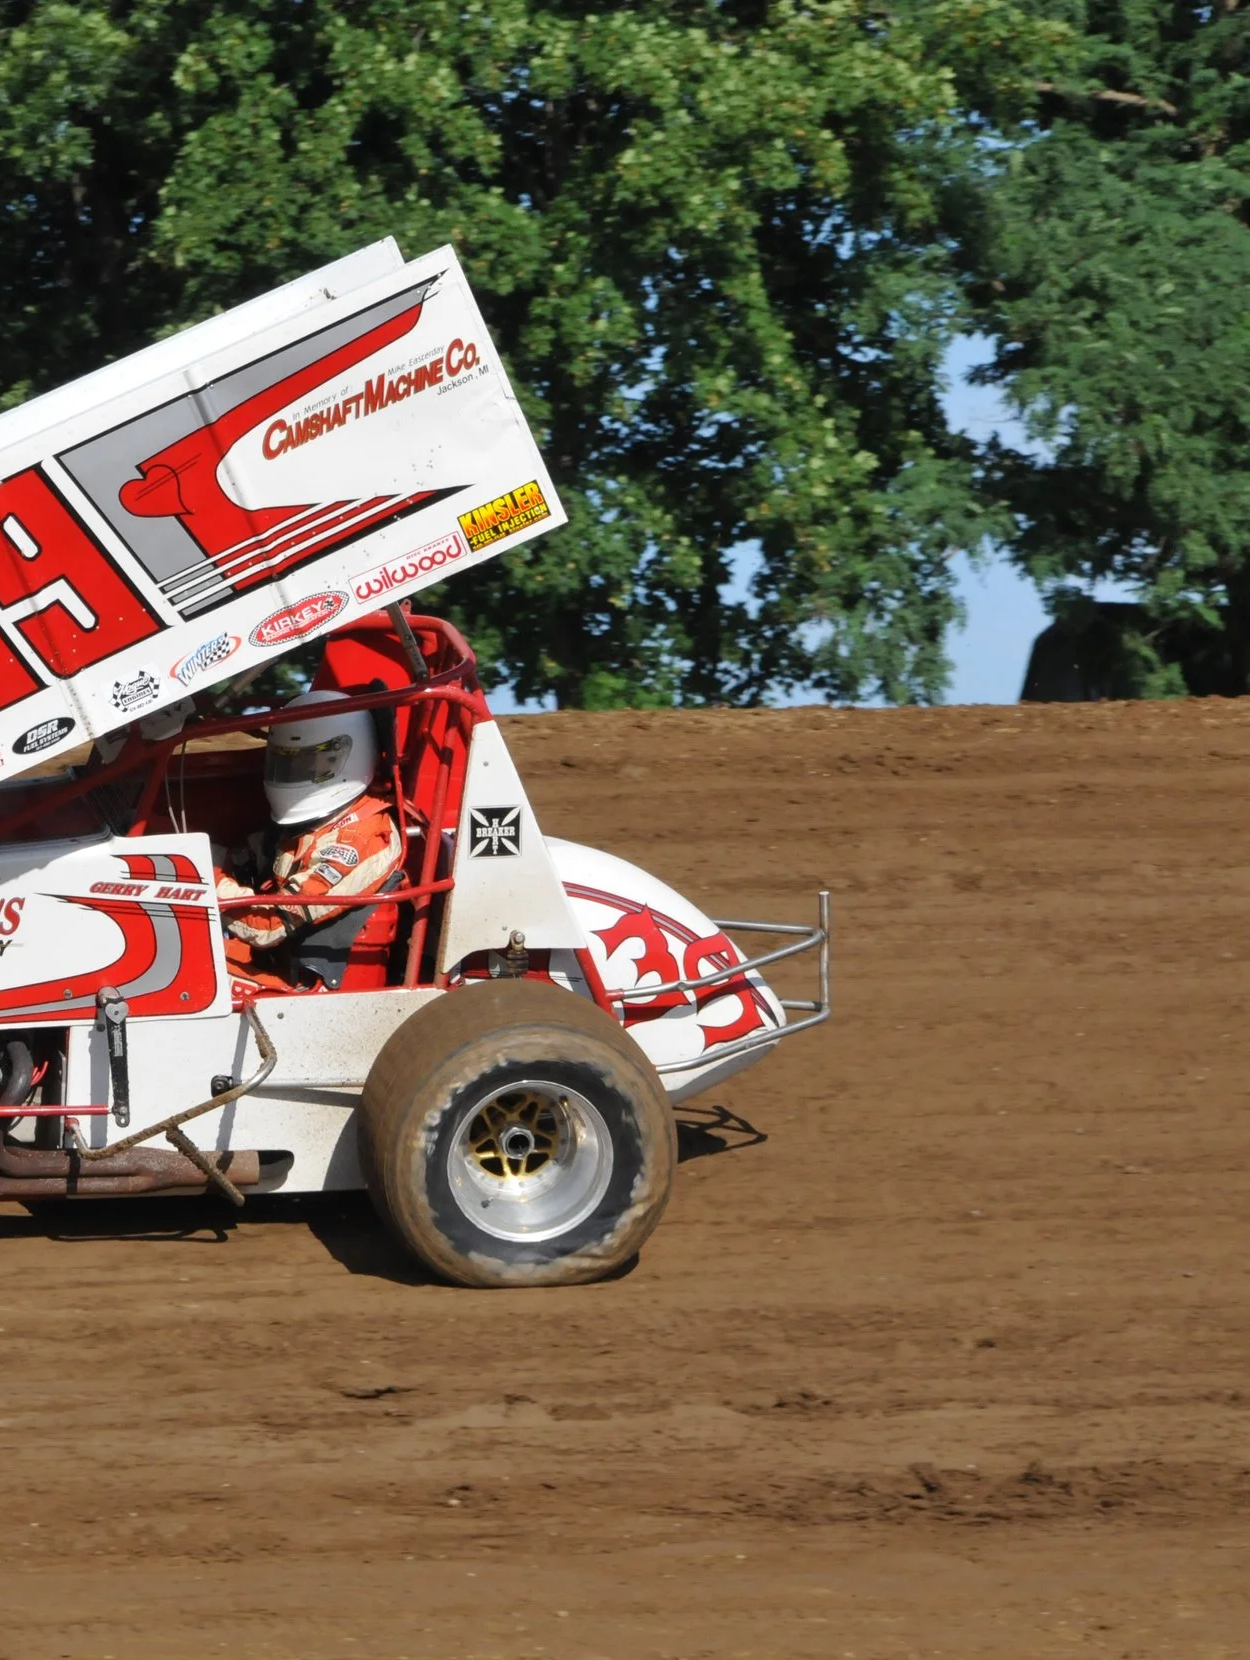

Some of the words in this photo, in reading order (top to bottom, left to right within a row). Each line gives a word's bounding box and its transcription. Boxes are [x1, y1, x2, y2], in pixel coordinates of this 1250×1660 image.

[304, 392, 338, 415] Memory
[387, 362, 407, 377] Mike
[363, 355, 445, 416] MACHINE
[478, 363, 490, 376] MI
[458, 481, 544, 538] KINSLER
[470, 529, 497, 545] FUEL
[497, 503, 548, 533] INJECTION
[355, 534, 463, 600] wilwood
[261, 600, 324, 637] KIRKEY
[177, 635, 226, 687] WINTERS
[26, 719, 59, 745] DSR
[476, 826, 516, 838] BREAKER
[88, 880, 150, 898] GERRY
[153, 885, 207, 902] HART
